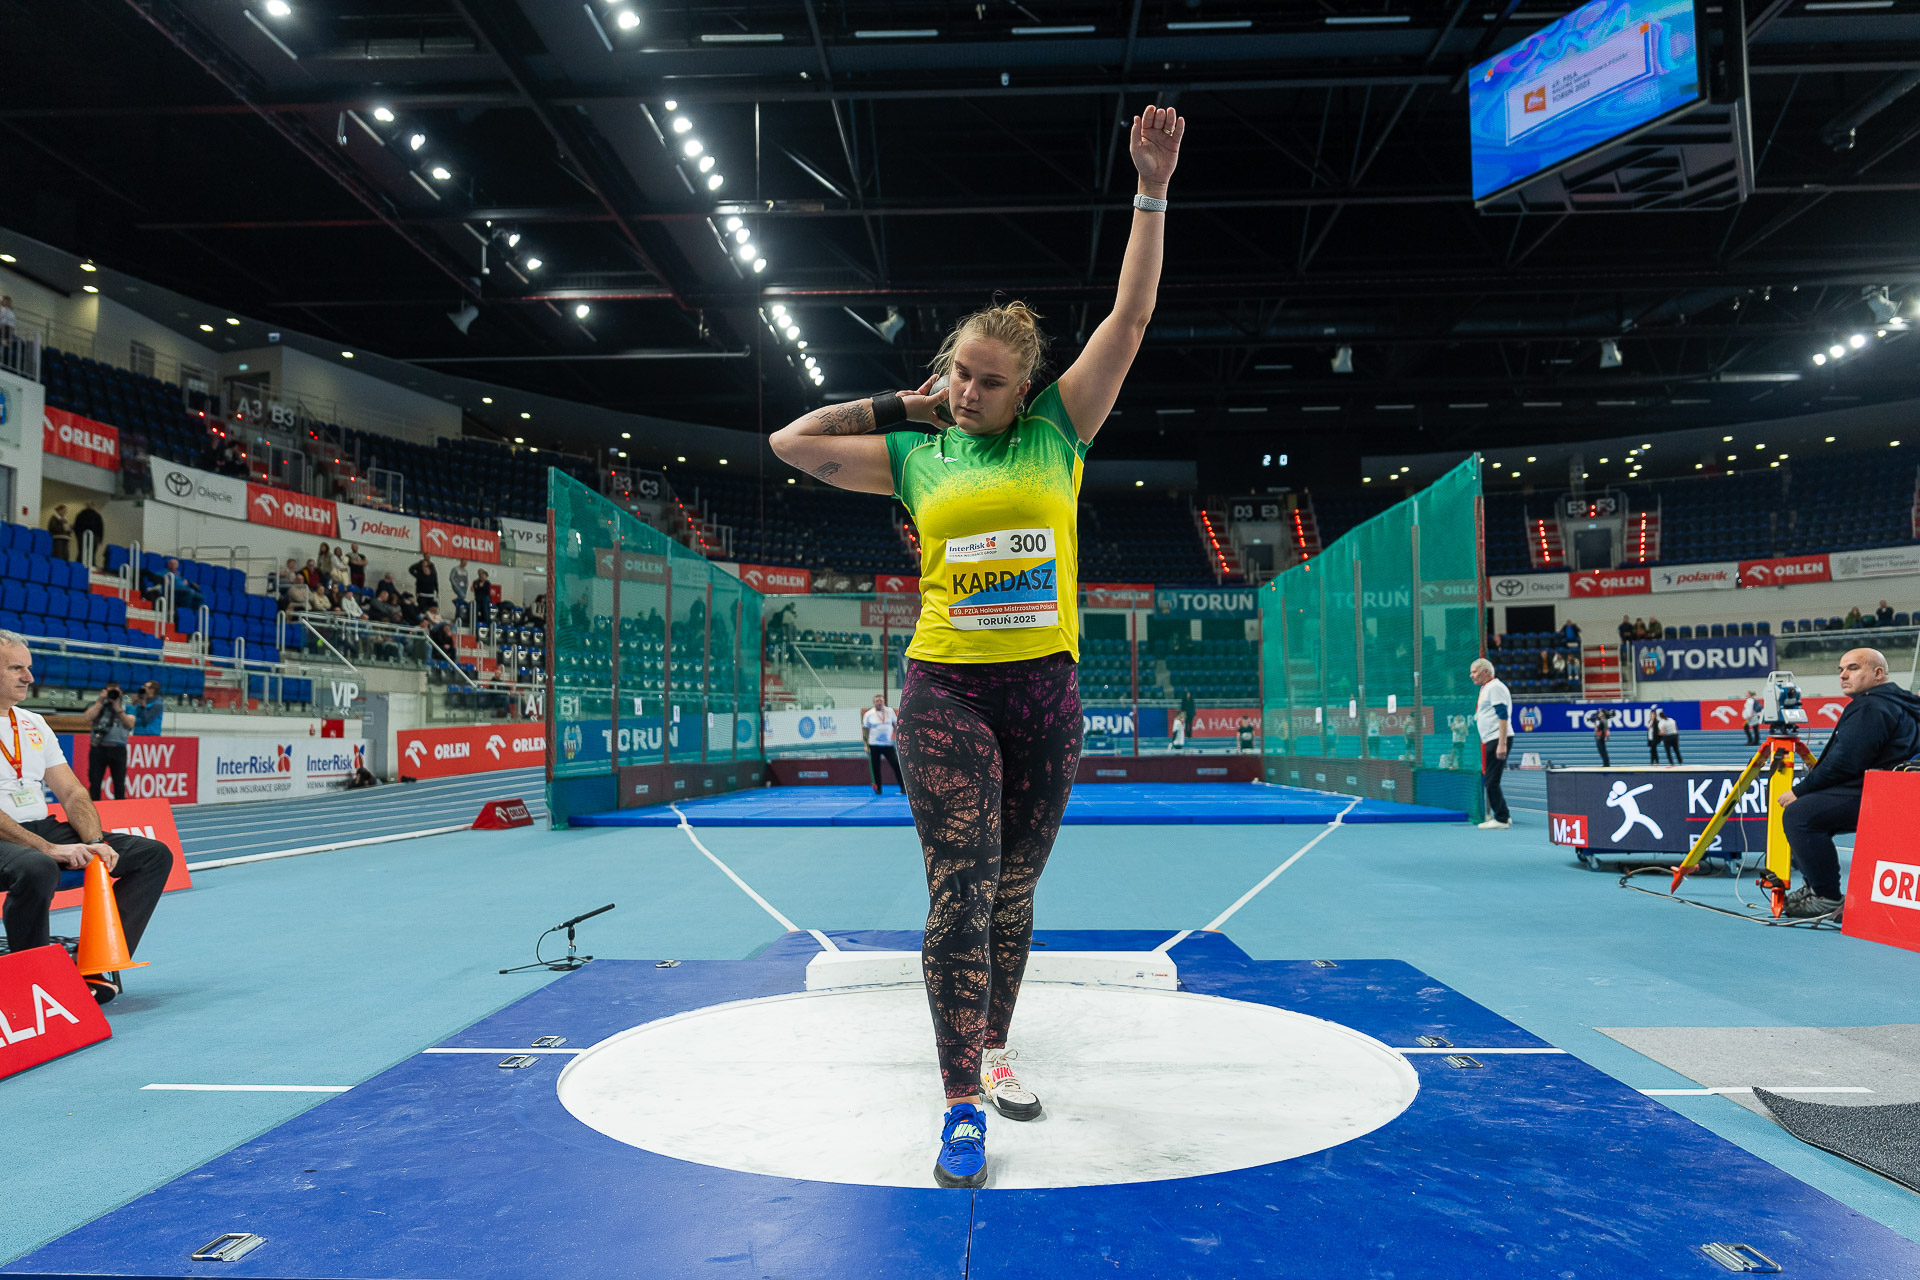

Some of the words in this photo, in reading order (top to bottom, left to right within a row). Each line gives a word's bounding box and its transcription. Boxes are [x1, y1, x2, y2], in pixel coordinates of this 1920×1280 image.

[237, 399, 263, 419] A3
[271, 405, 296, 427] B3
[59, 424, 115, 455] ORLEN
[640, 479, 659, 496] C3
[283, 501, 331, 525] ORLEN
[1233, 505, 1253, 518] D3
[1261, 504, 1279, 518] E3
[1567, 501, 1587, 514] E3
[360, 518, 411, 540] polanik
[510, 528, 533, 543] TVP
[451, 534, 495, 553] ORLEN
[949, 541, 985, 553] InterRisk
[1009, 533, 1047, 553] 300
[624, 558, 664, 575] ORLEN
[1773, 562, 1824, 577] ORLEN
[766, 574, 806, 588] ORLEN
[952, 568, 1053, 595] KARDASZ
[1600, 575, 1645, 588] ORLEN
[1676, 569, 1728, 586] polanik
[1531, 581, 1565, 594] Okęcie
[977, 614, 1012, 626] TORUŃ
[1013, 615, 1037, 624] 2025
[1667, 640, 1768, 670] TORUŃ
[331, 680, 359, 708] VIP
[525, 694, 543, 716] A1
[560, 696, 580, 717] B1
[434, 742, 470, 760] ORLEN
[216, 755, 276, 775] InterRisk
[306, 754, 352, 772] InterRisk
[1553, 818, 1586, 845] M:1
[991, 1066, 1015, 1083] NIKE
[950, 1123, 982, 1140] NIKE
